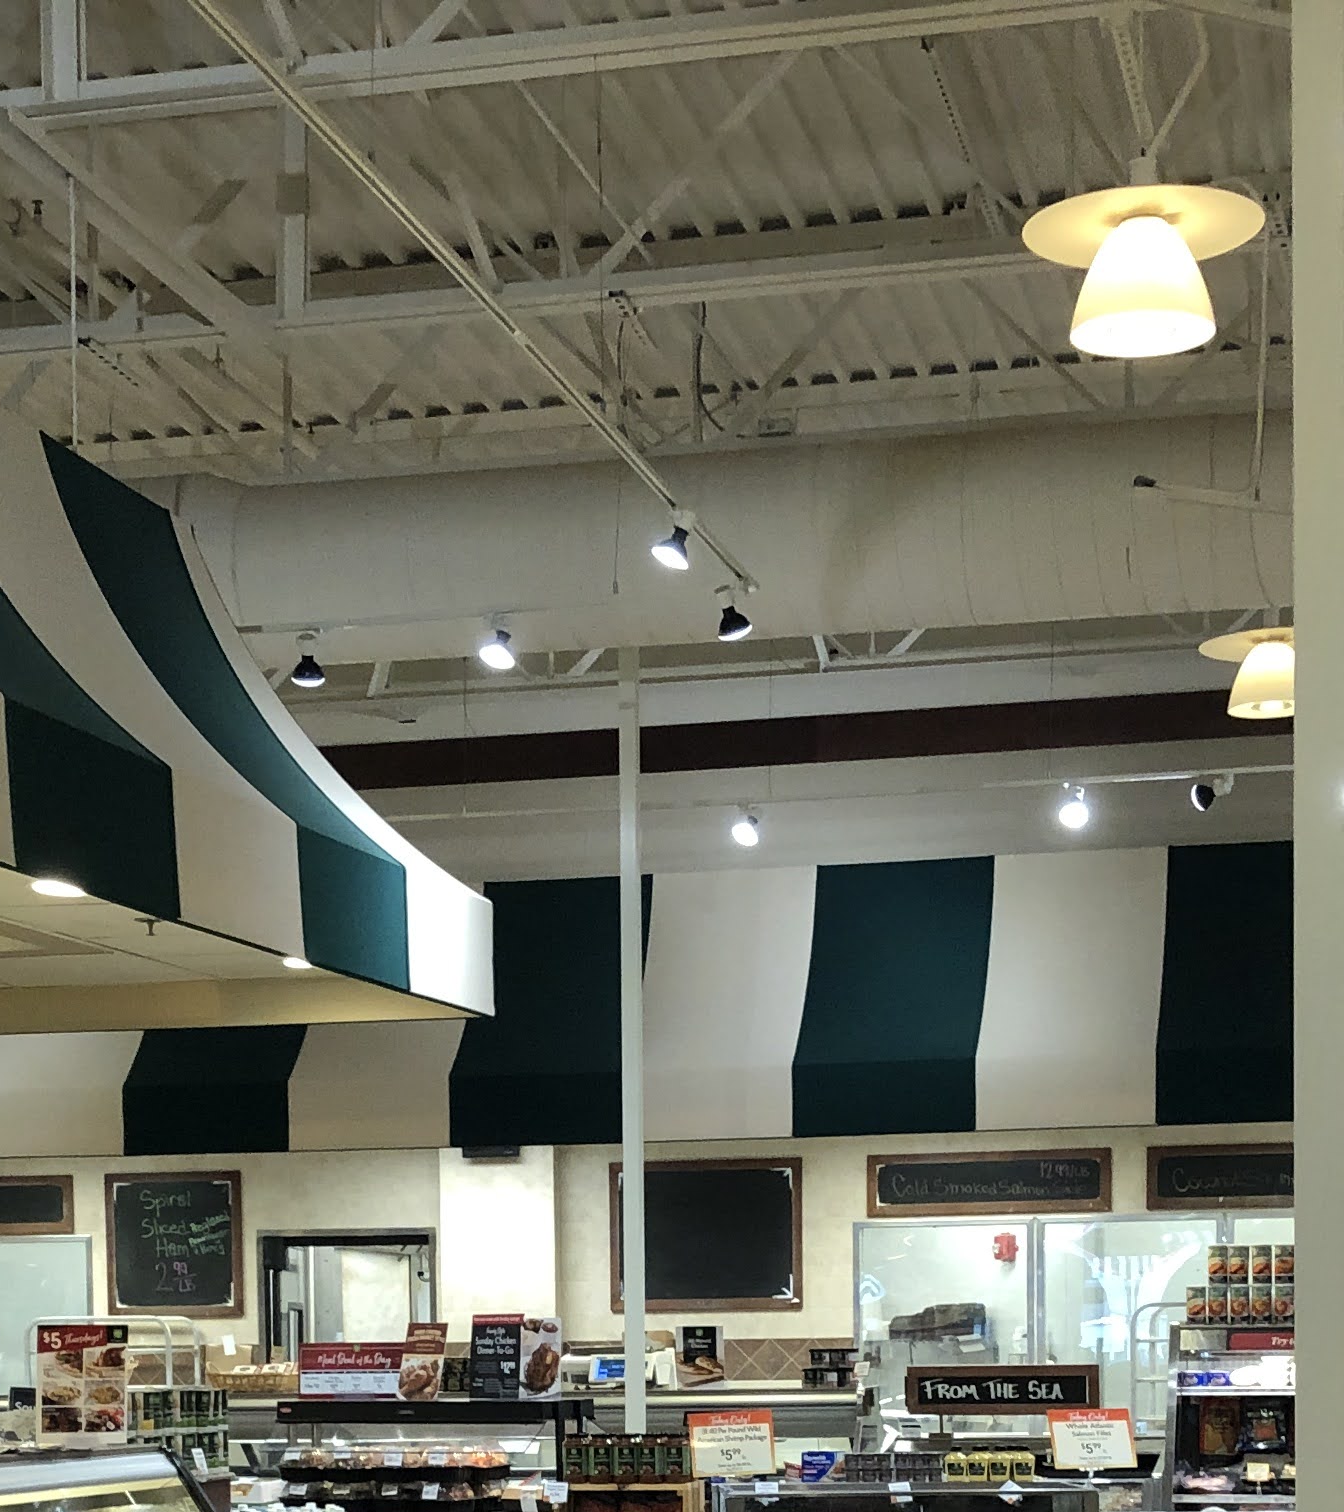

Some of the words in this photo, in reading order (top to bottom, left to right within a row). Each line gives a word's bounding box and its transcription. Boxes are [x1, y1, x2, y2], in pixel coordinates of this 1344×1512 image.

[140, 1190, 191, 1217] Spiral
[141, 1218, 189, 1239] Sliced
[43, 1331, 62, 1350] $5
[920, 1379, 980, 1400] FROM
[982, 1379, 1020, 1400] THE
[1028, 1380, 1064, 1400] SEA
